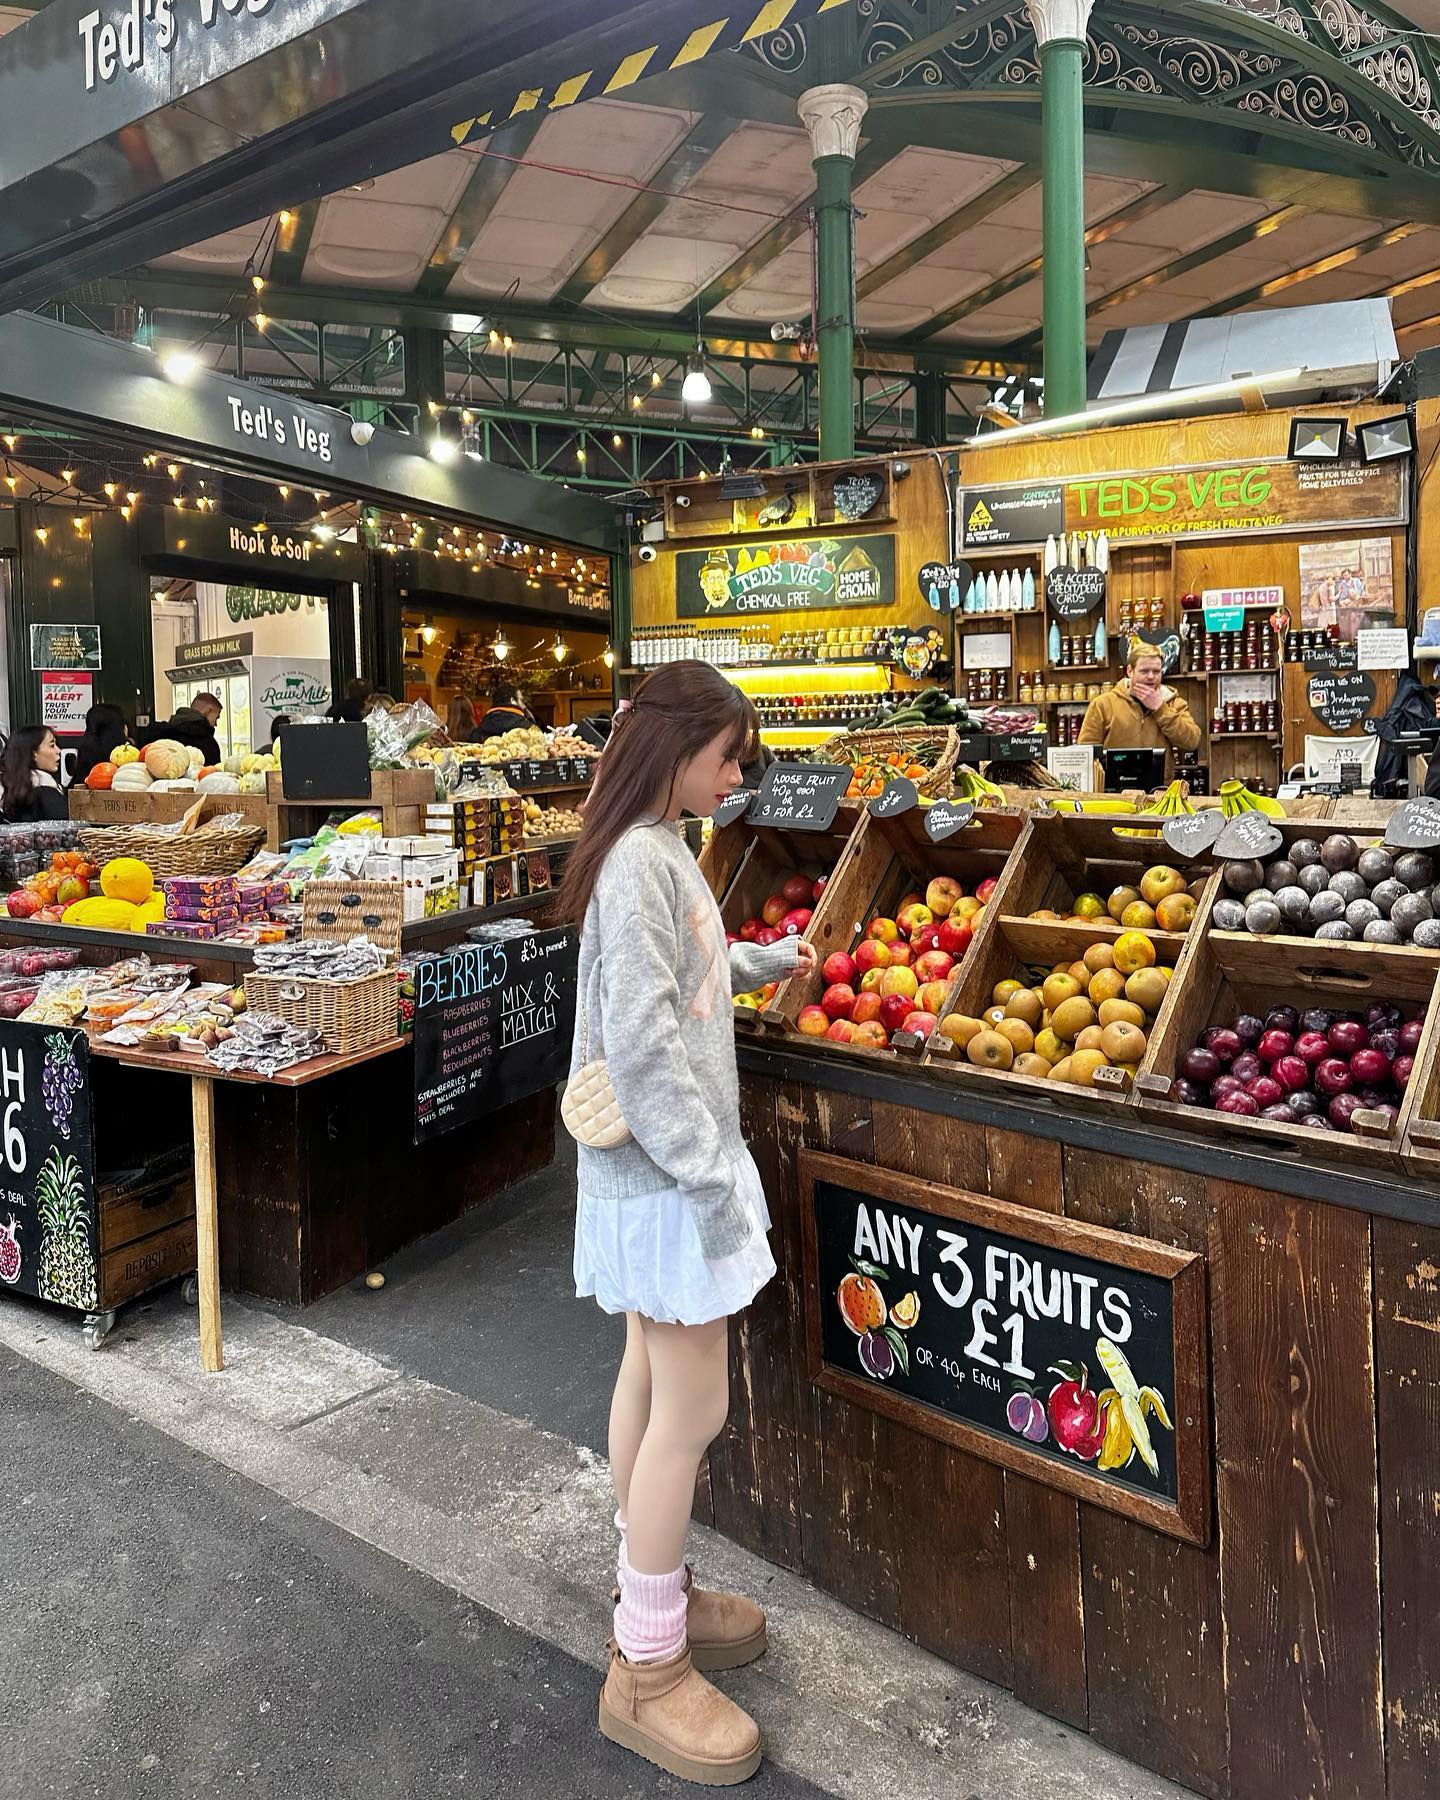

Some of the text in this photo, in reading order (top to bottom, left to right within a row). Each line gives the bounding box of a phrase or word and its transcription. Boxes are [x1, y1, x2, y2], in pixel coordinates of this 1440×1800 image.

[227, 396, 332, 462] Ted's Veg
[1298, 468, 1381, 481] FRUITS FOR THE OFFICE
[1069, 466, 1272, 518] TED'S VEG
[1299, 478, 1364, 490] HOME DELIVERIES
[968, 523, 990, 531] CCTV
[1172, 521, 1186, 532] OF
[1188, 518, 1221, 530] FRESH
[229, 527, 311, 561] Hook & Son
[736, 563, 821, 593] TED'S VEG
[840, 570, 870, 584] HOME
[922, 567, 946, 579] Ted's
[945, 565, 960, 579] Veg
[1050, 573, 1063, 585] WE
[837, 583, 876, 599] GROWN
[1048, 582, 1104, 595] CREDIT/DEBIT
[736, 591, 811, 610] CHEMICAL FREE
[1056, 593, 1086, 605] CARDS
[184, 640, 240, 659] GRASS FED RAW MILK
[1305, 649, 1358, 660] Plastic Bag
[45, 685, 74, 693] STAY
[1338, 678, 1348, 686] US
[1351, 675, 1363, 684] ON
[45, 693, 83, 701] ALERT
[260, 685, 330, 706] Raw Milk
[1330, 691, 1371, 707] Instagram
[773, 774, 837, 786] LOOSE FRUIT
[771, 785, 815, 797] 40p each
[124, 800, 137, 812] VEG
[720, 798, 746, 808] FRANCE
[782, 796, 793, 806] OR
[762, 804, 815, 818] 3 FOR £1
[1405, 803, 1440, 821] PASSIO
[1168, 817, 1206, 832] RUSSET
[1183, 826, 1201, 834] UK
[1242, 816, 1267, 840] PLUM
[1407, 825, 1440, 838] PERU
[1235, 824, 1260, 849] SPAIN
[520, 935, 568, 963] £3 a punnet
[419, 943, 508, 1008] BERRIES
[501, 971, 561, 1014] MIX &
[443, 996, 491, 1020] RASPBERRIES
[443, 1015, 489, 1041] BLUEBERRIES
[501, 1003, 557, 1046] MATCH
[443, 1031, 491, 1060] BLACKBERRIES
[443, 1047, 493, 1074] REDCURRANTS
[418, 1068, 483, 1104] STRAWBERRIES ARE
[418, 1082, 477, 1114] NOT INCLUDED IN
[419, 1103, 455, 1126] THIS DEAL
[8, 1191, 27, 1207] DEAL
[125, 1247, 168, 1280] DEPOSIT
[854, 1202, 1133, 1343] ANY 3 FRUITS
[963, 1298, 1035, 1380] £1
[916, 1346, 1001, 1393] OR 40p EACH
